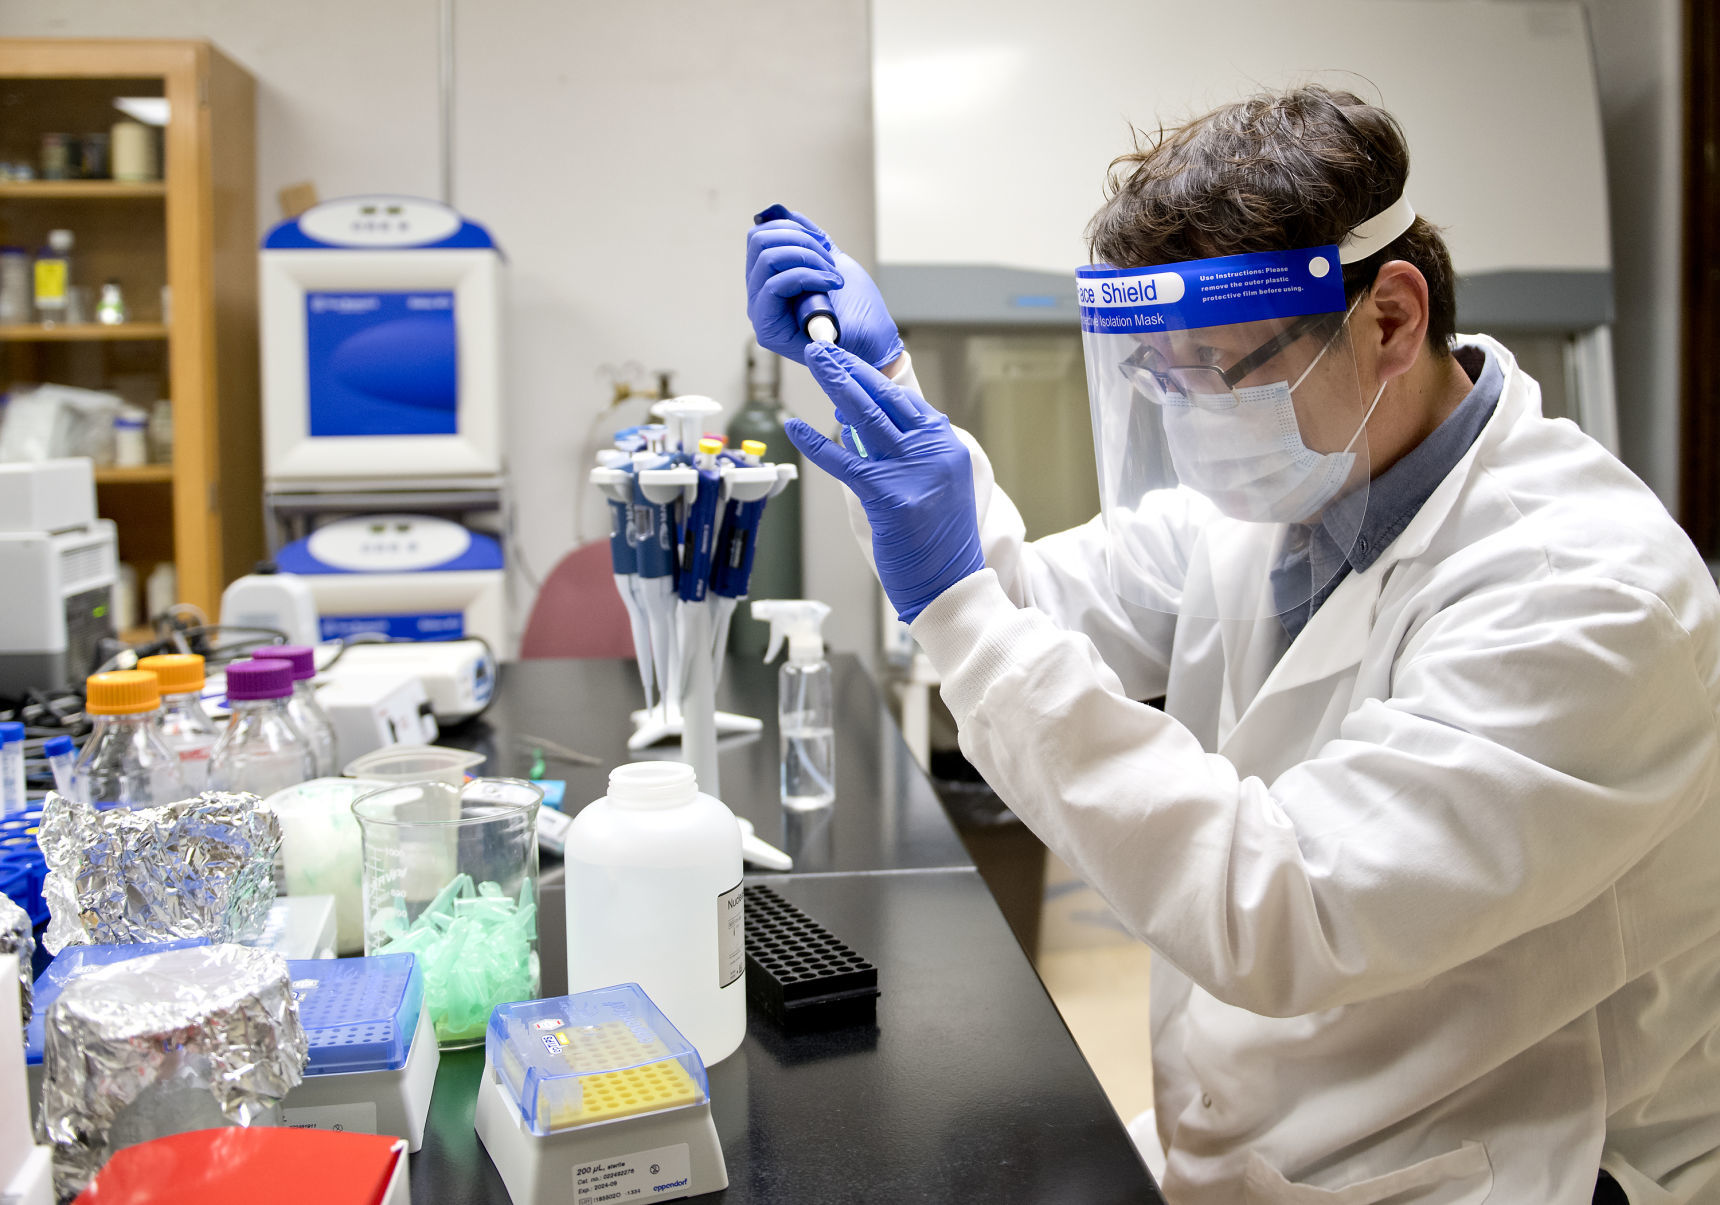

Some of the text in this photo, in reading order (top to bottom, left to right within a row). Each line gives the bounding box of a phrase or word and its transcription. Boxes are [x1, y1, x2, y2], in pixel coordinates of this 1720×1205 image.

[1216, 269, 1264, 279] Instructions:
[1077, 279, 1158, 304] ace Shield
[1201, 284, 1228, 292] remove
[1266, 276, 1289, 284] plastic
[1203, 293, 1242, 303] protective
[1259, 287, 1282, 295] before
[1284, 285, 1304, 293] using.
[1100, 315, 1133, 327] Isolation
[1134, 312, 1165, 326] Mask
[576, 1166, 592, 1176] 200
[653, 1177, 688, 1192] eppendorf
